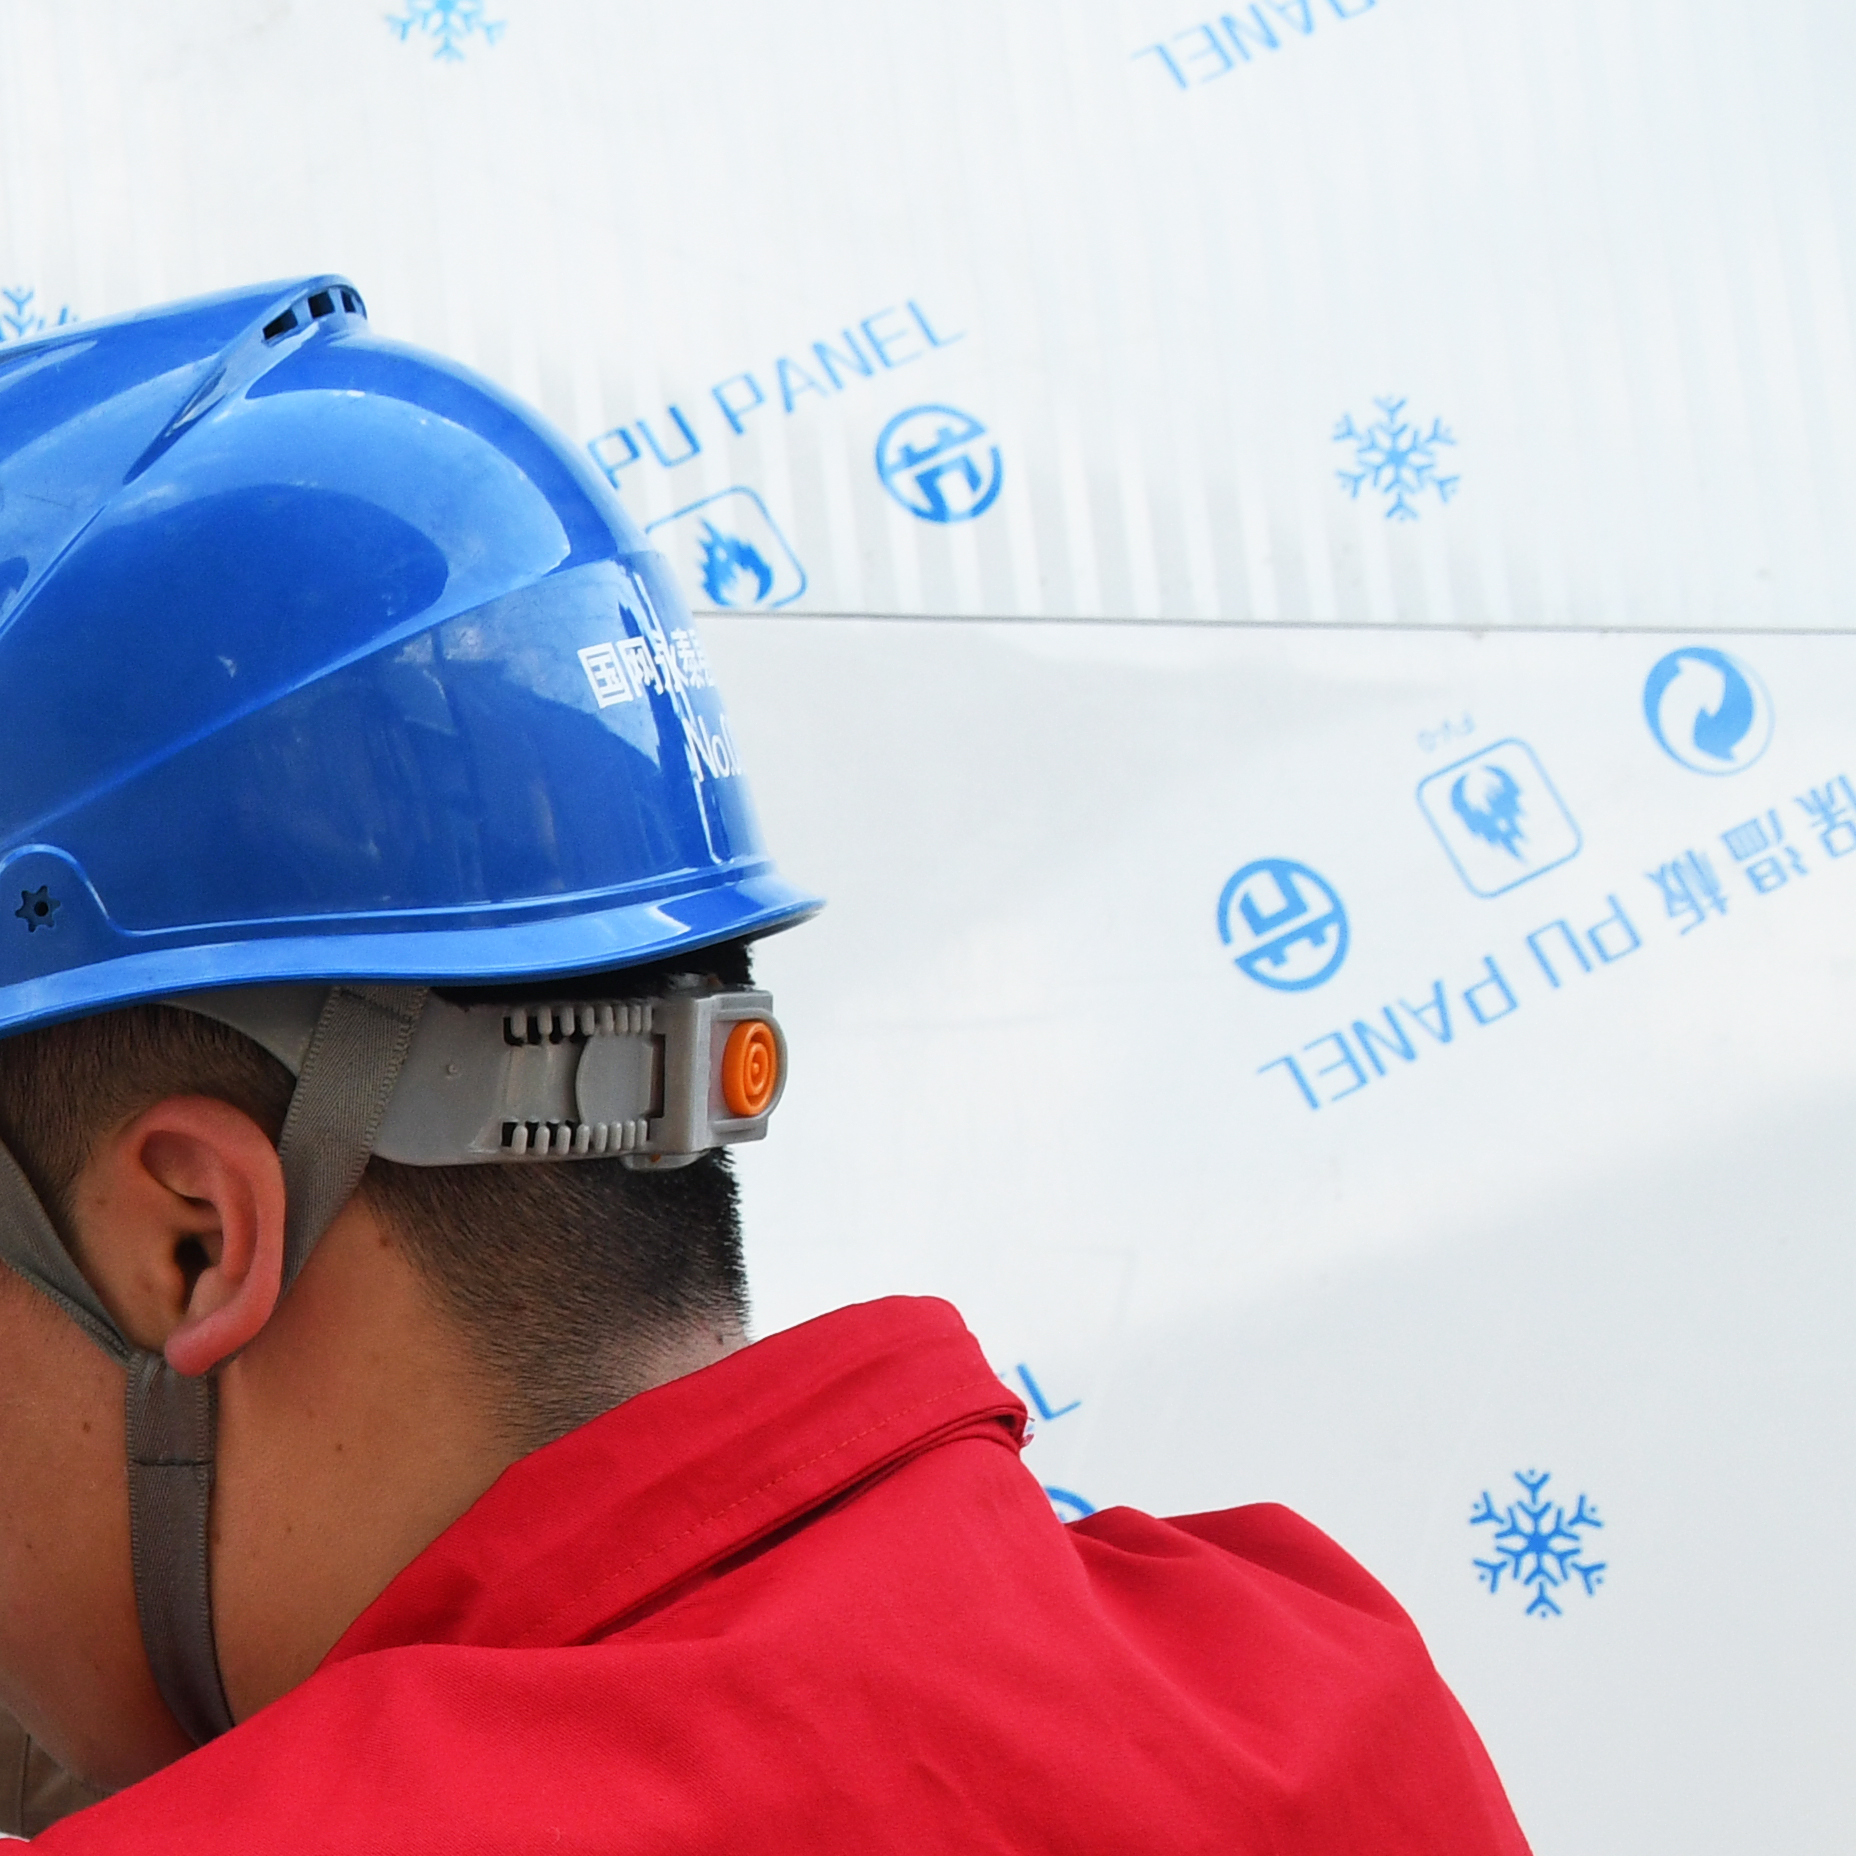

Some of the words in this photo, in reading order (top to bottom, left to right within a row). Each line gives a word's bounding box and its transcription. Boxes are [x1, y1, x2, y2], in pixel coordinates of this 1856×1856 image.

[587, 404, 702, 490] PU
[711, 299, 967, 436] PANEL
[1525, 894, 1643, 990] PU
[1254, 953, 1520, 1112] PANEL
